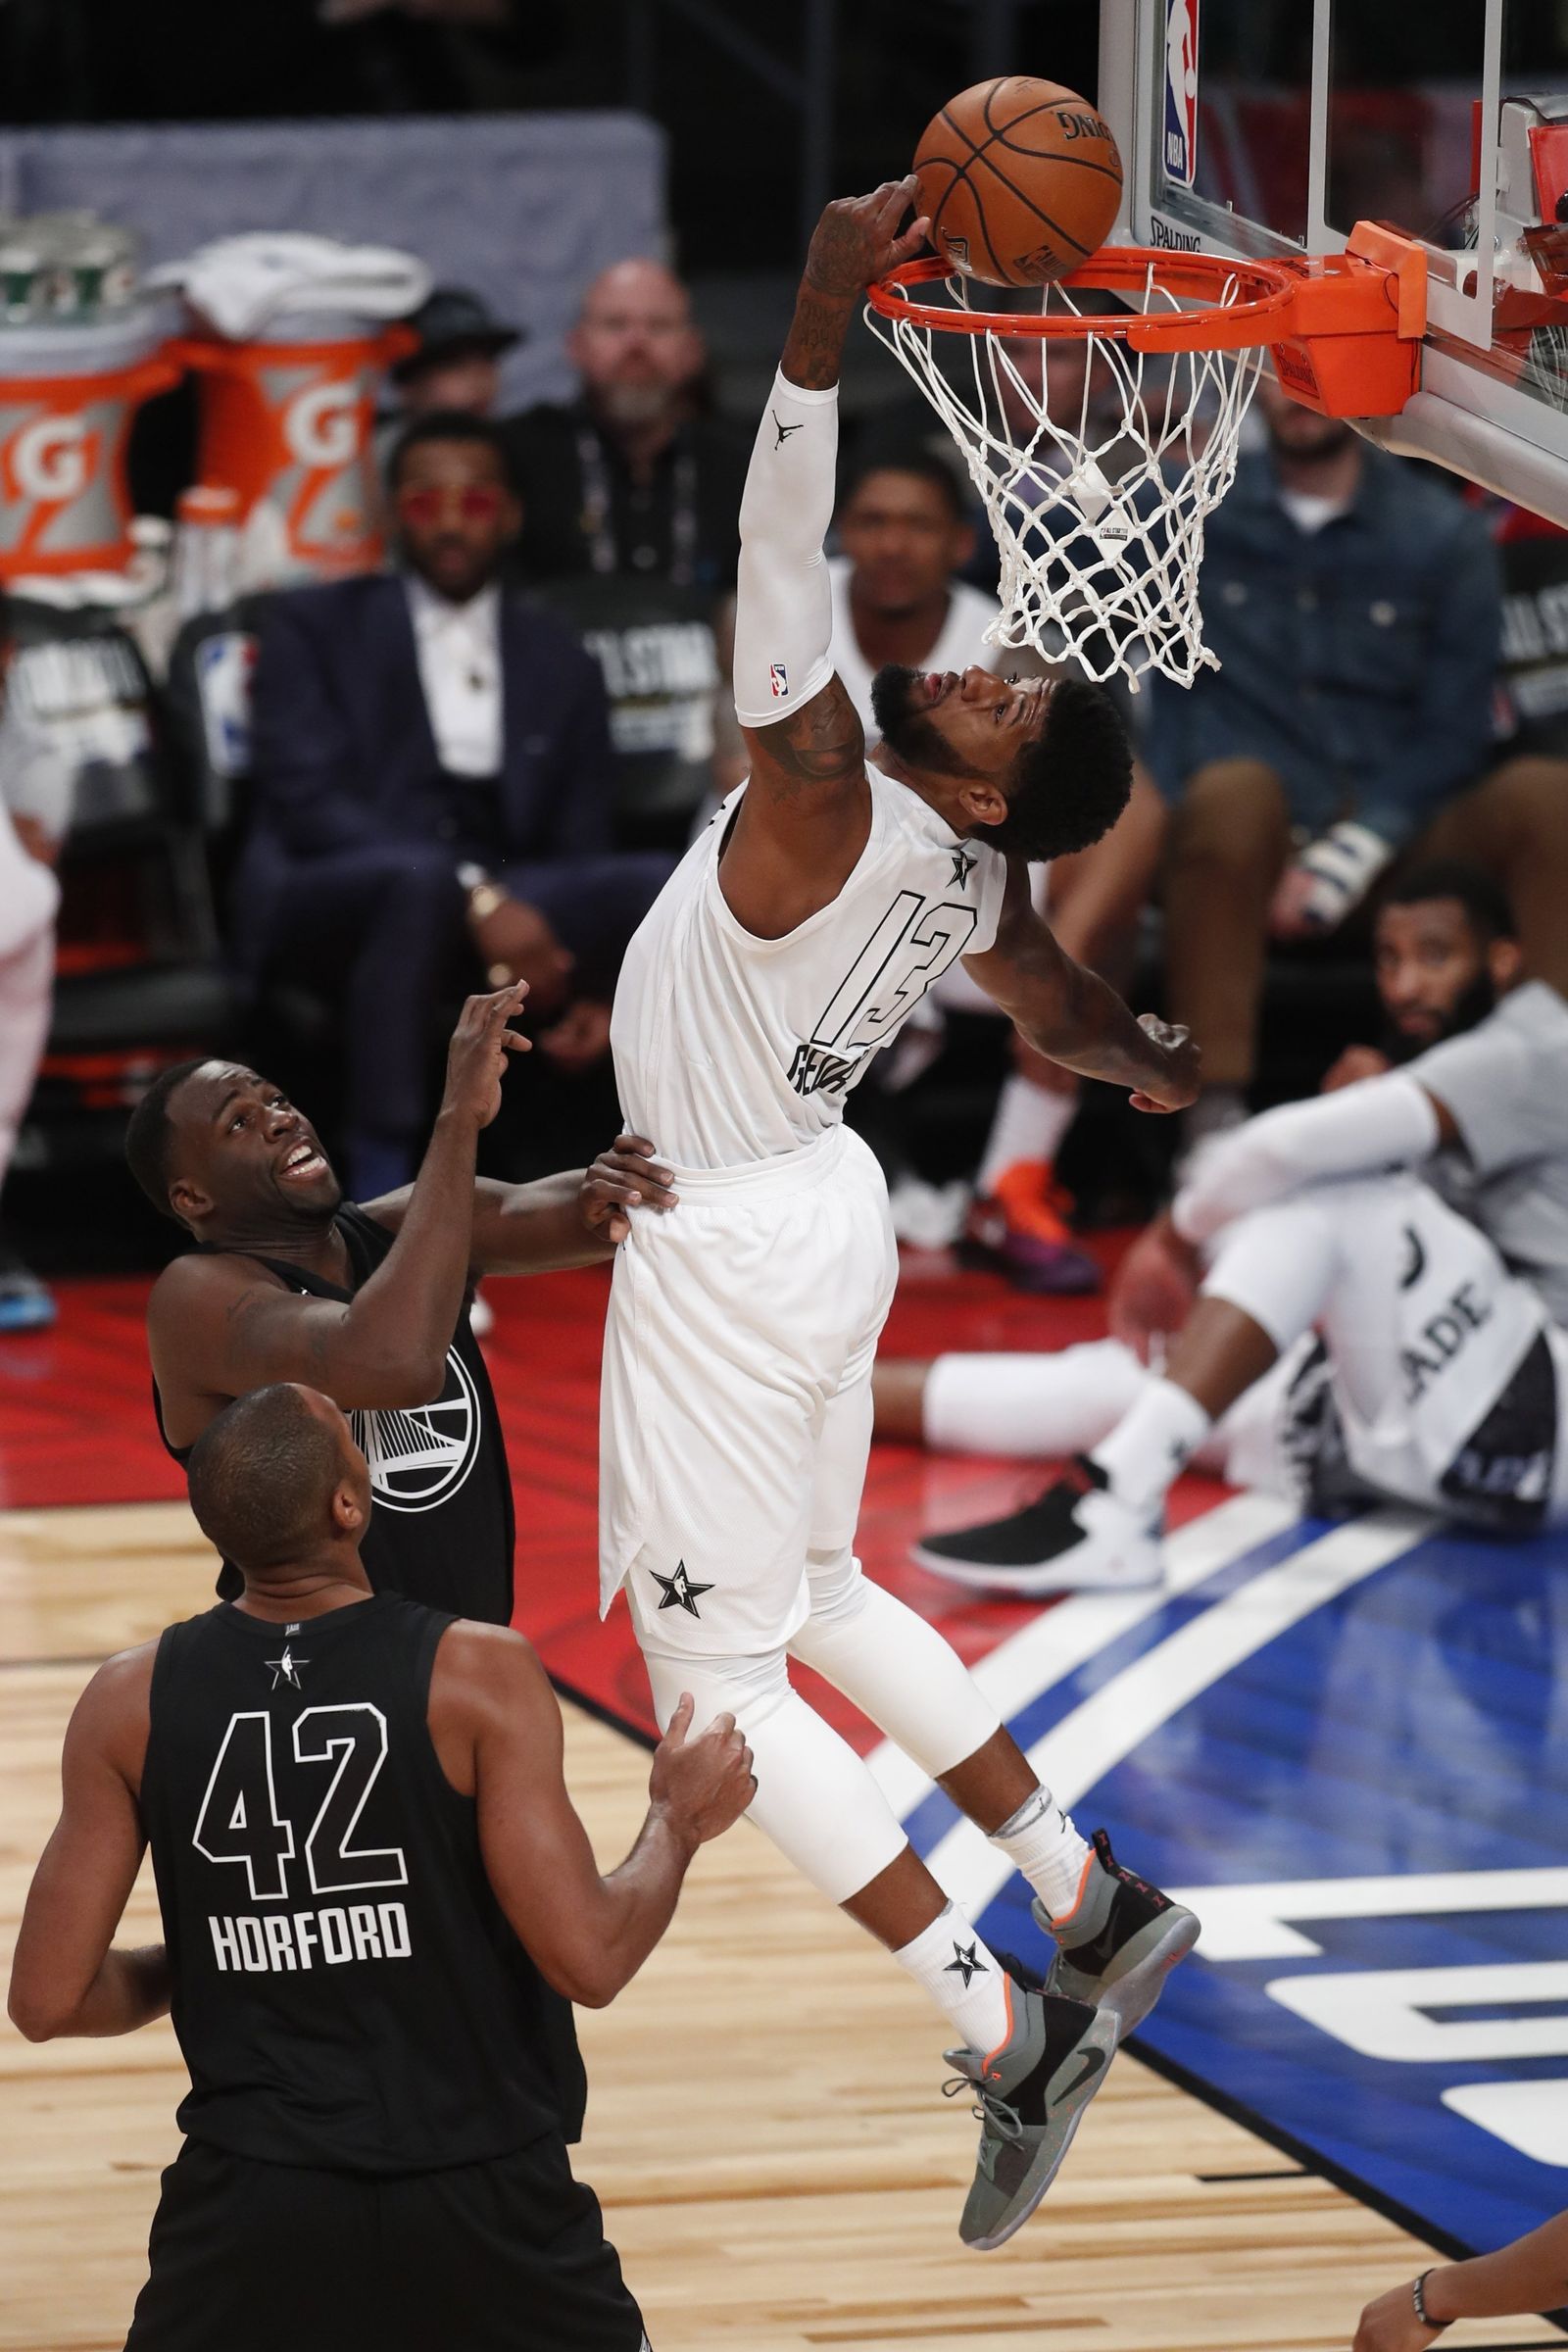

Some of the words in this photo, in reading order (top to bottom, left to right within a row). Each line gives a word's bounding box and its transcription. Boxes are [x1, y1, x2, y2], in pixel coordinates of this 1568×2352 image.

[1166, 130, 1184, 171] NBA
[1150, 215, 1201, 253] SPALDING
[11, 413, 87, 502] G
[283, 380, 359, 467] G
[809, 890, 978, 1049] 13
[191, 1701, 410, 1901] 42
[208, 1902, 413, 1973] HORFORD
